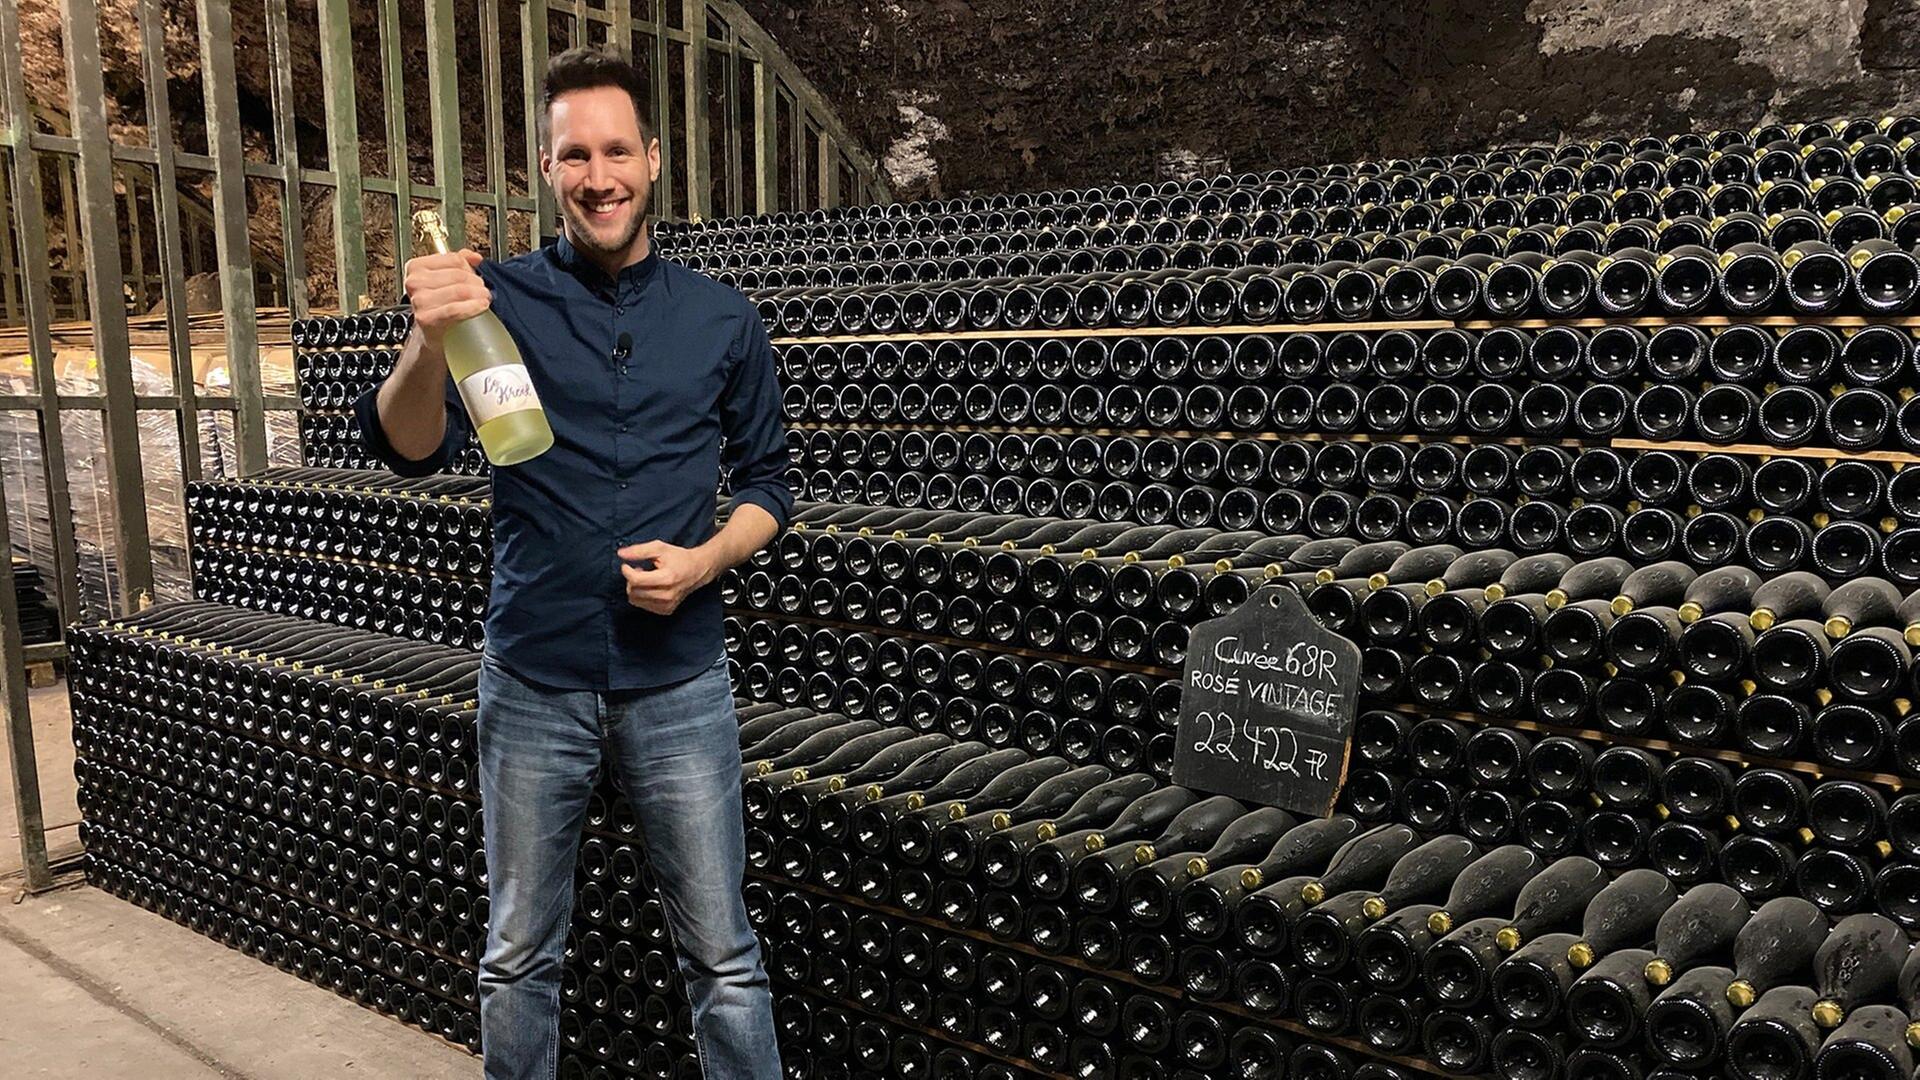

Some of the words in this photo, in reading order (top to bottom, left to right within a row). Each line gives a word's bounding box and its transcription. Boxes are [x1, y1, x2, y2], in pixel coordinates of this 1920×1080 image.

[1214, 636, 1283, 672] Cuvée
[1285, 641, 1338, 686] 68R
[1190, 670, 1240, 695] ROSÉ
[1247, 679, 1344, 717] VINTAGE
